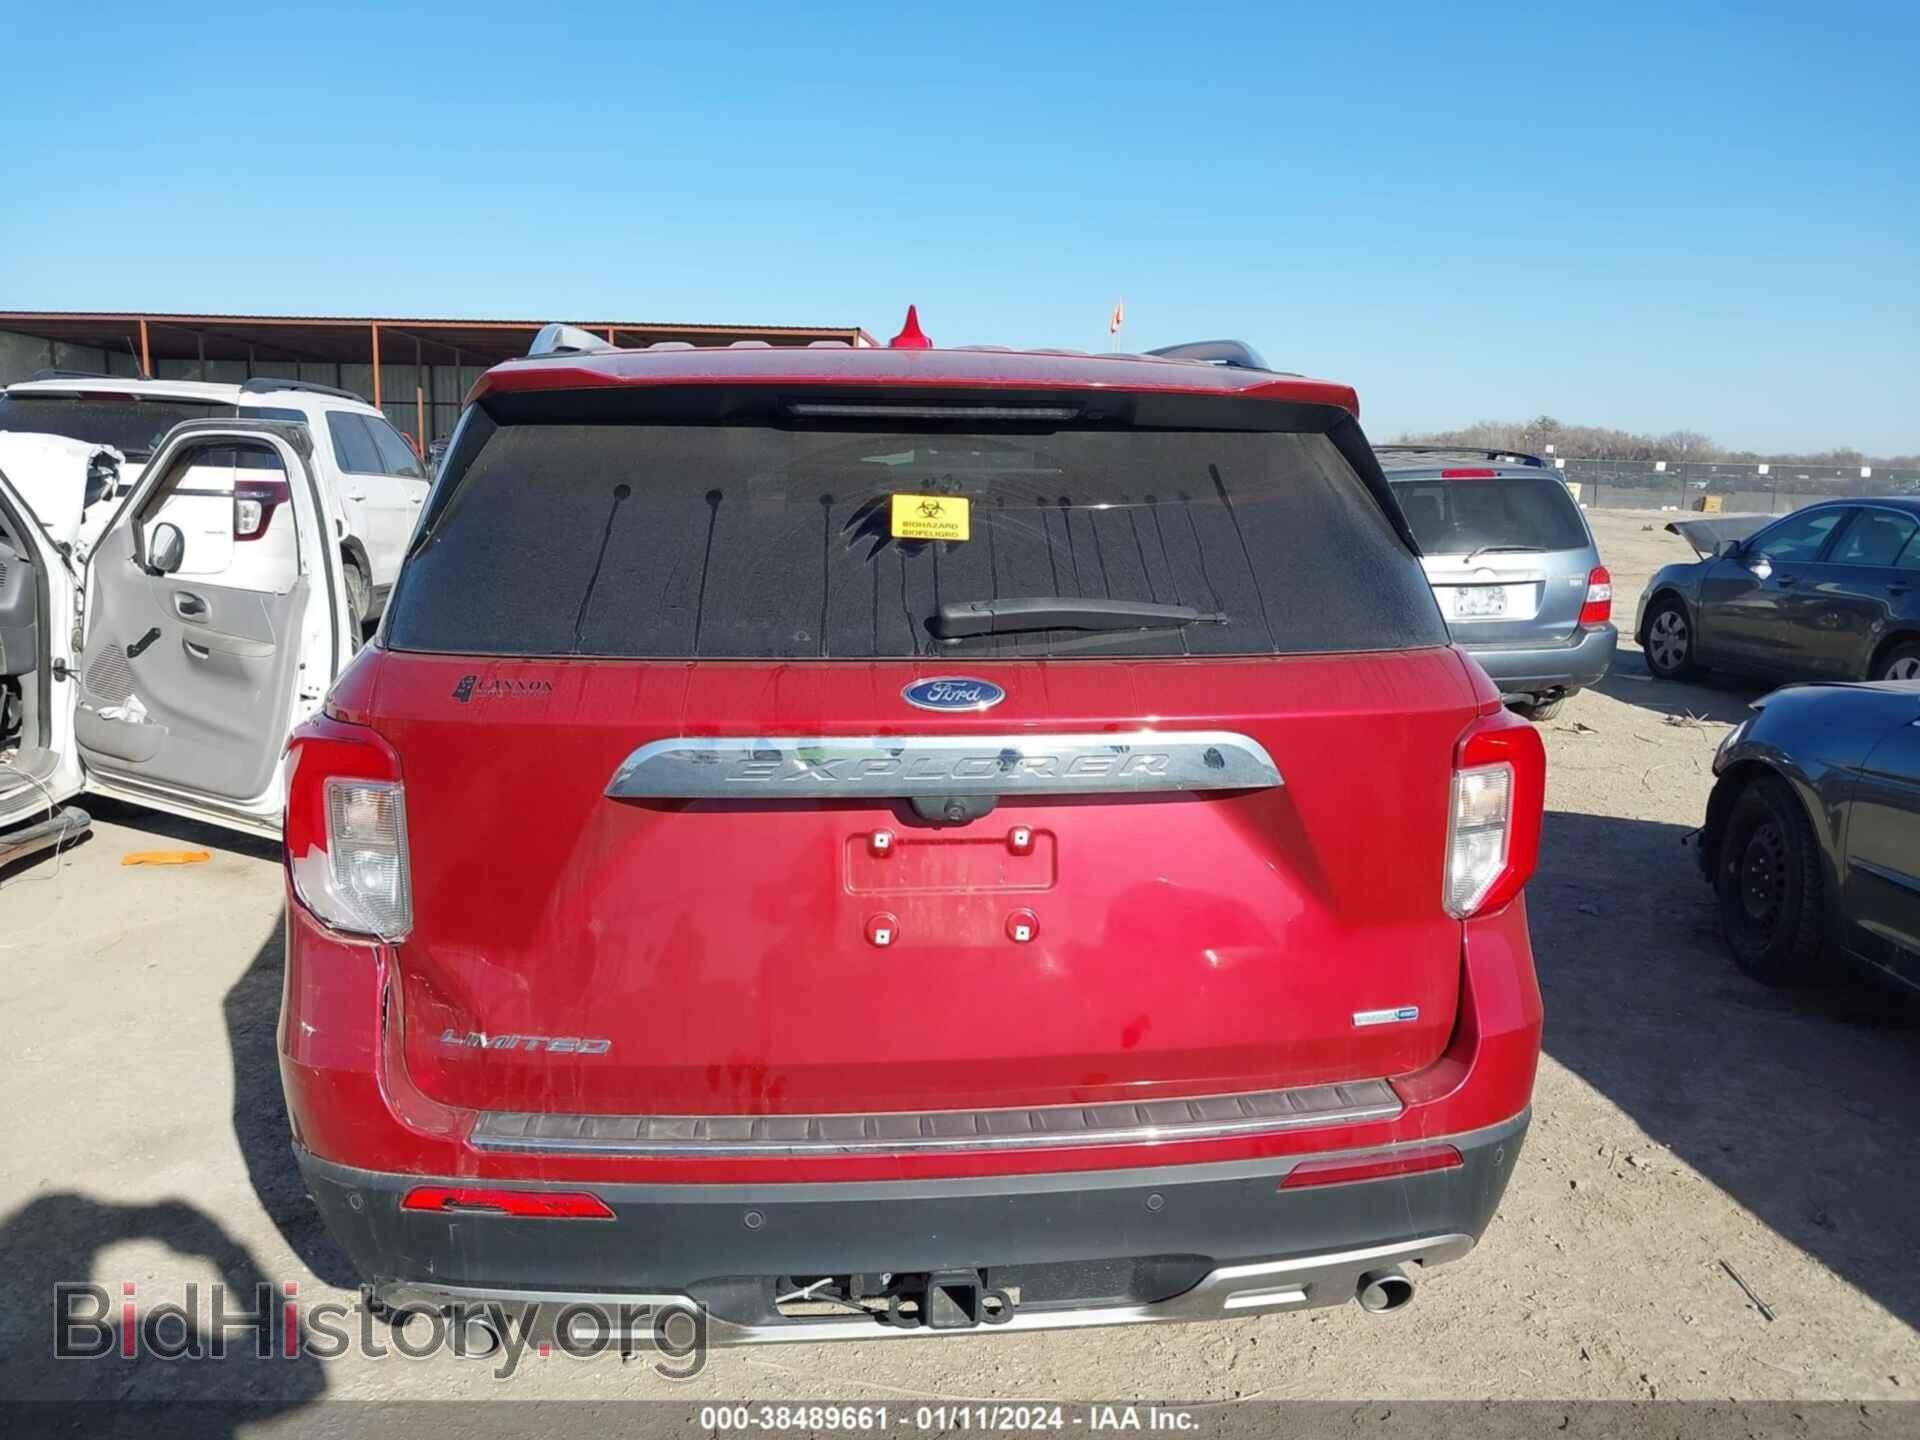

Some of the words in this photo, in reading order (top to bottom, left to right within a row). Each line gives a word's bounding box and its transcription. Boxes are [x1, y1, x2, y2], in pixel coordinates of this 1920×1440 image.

[902, 521, 959, 530] BIOHAZARD
[927, 681, 982, 702] Ford
[724, 753, 1170, 782] EXPLORER
[440, 1028, 612, 1053] LIMITED
